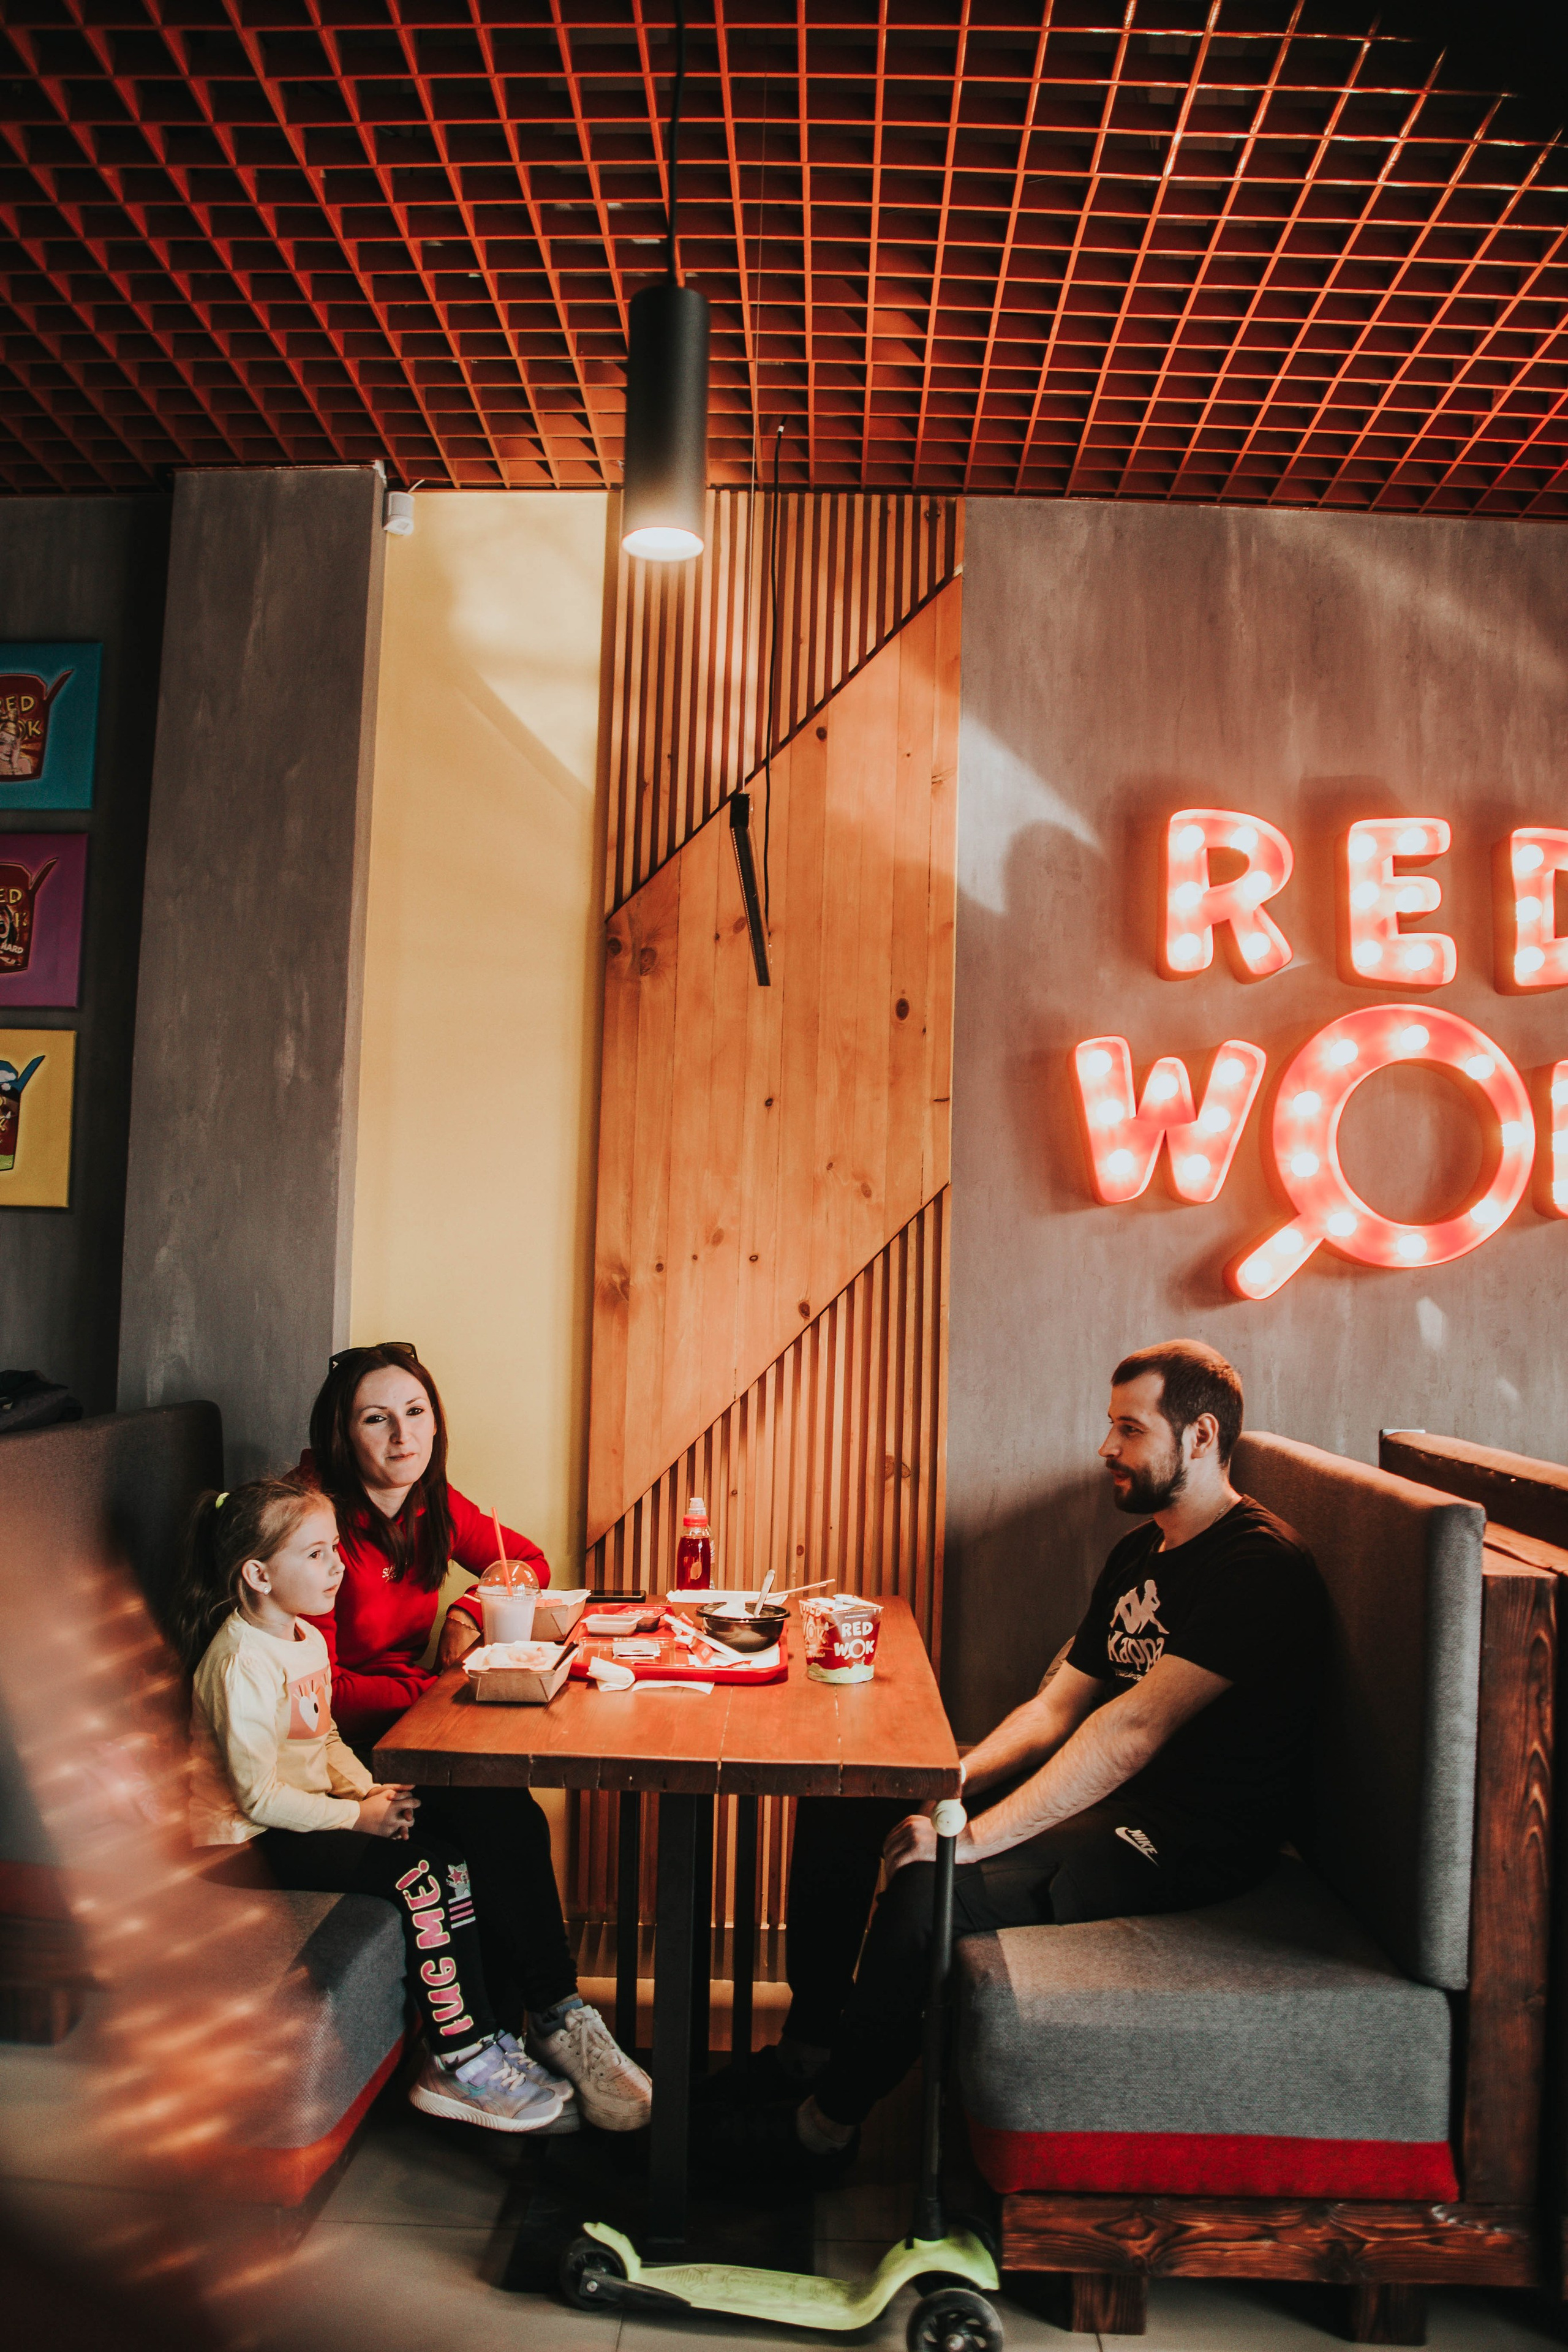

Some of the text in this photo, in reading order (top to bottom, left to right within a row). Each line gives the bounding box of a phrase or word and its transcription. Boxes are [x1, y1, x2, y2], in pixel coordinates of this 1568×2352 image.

[0, 695, 35, 712] ED
[1073, 1004, 1568, 1300] WO
[842, 1621, 873, 1638] RED
[834, 1638, 875, 1660] WOK
[1107, 1630, 1164, 1672] Kappa
[1128, 1830, 1158, 1853] NIKE
[395, 1860, 450, 1949] ME!
